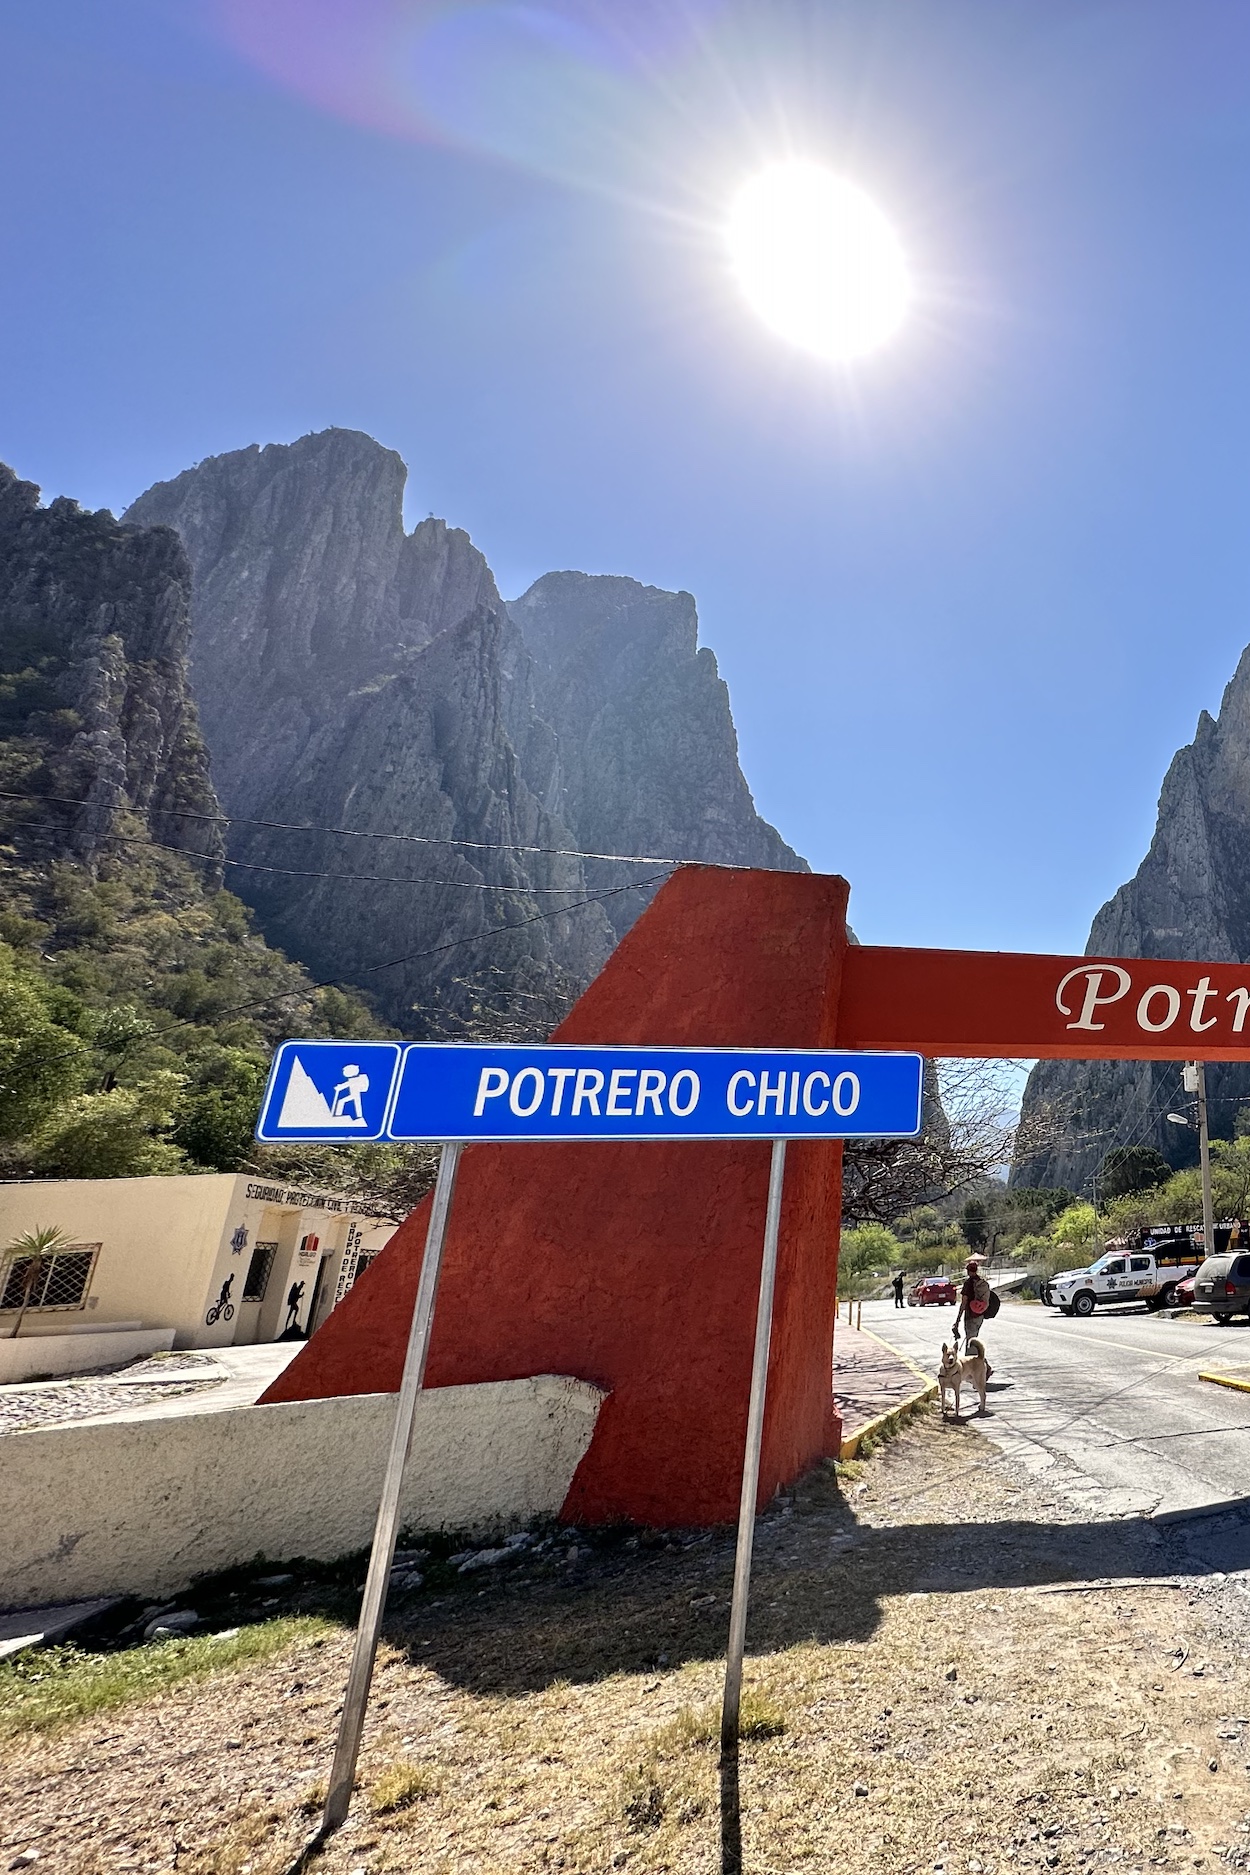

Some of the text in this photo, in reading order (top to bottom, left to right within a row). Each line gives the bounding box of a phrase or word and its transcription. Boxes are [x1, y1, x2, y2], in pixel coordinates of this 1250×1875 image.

[473, 1067, 861, 1117] POTRERO CHICO
[345, 1222, 357, 1255] GRUPO
[1150, 1227, 1171, 1235] UNIDAD
[341, 1259, 349, 1272] DE
[347, 1232, 363, 1279] POTRERO
